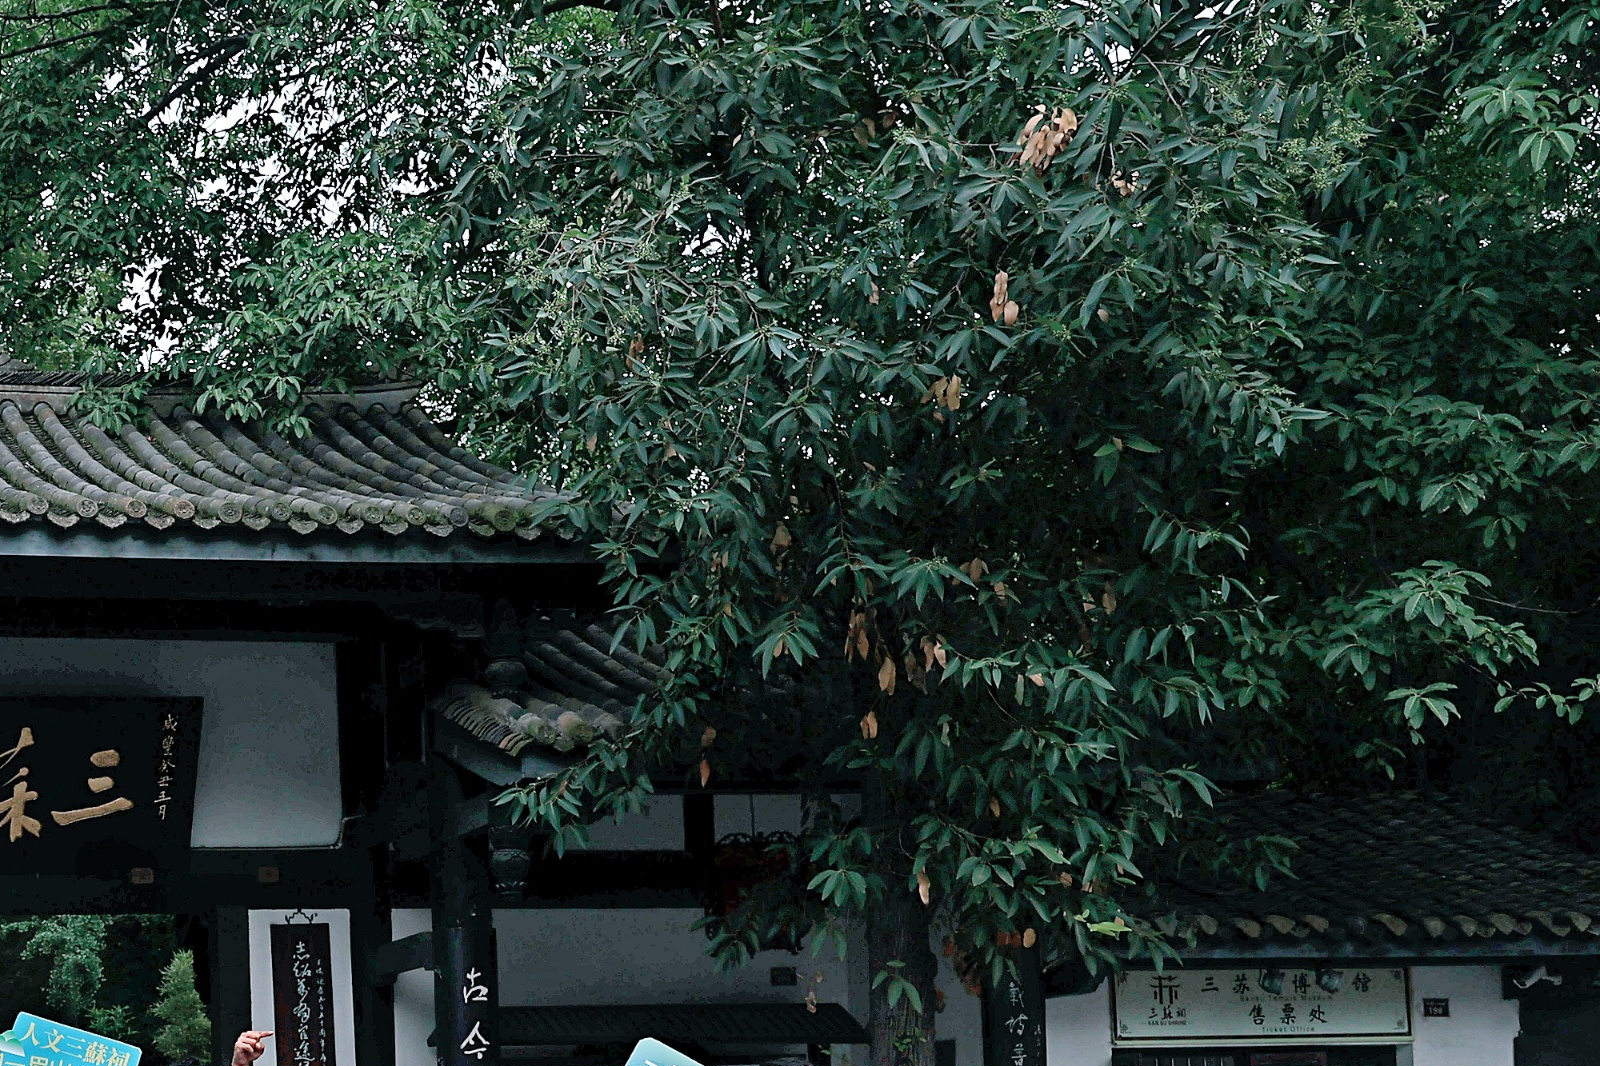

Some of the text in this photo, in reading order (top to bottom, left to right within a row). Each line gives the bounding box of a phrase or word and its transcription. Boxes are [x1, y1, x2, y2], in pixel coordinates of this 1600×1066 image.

[1201, 972, 1372, 994] 三苏博馆
[1248, 1003, 1328, 1025] 售票处
